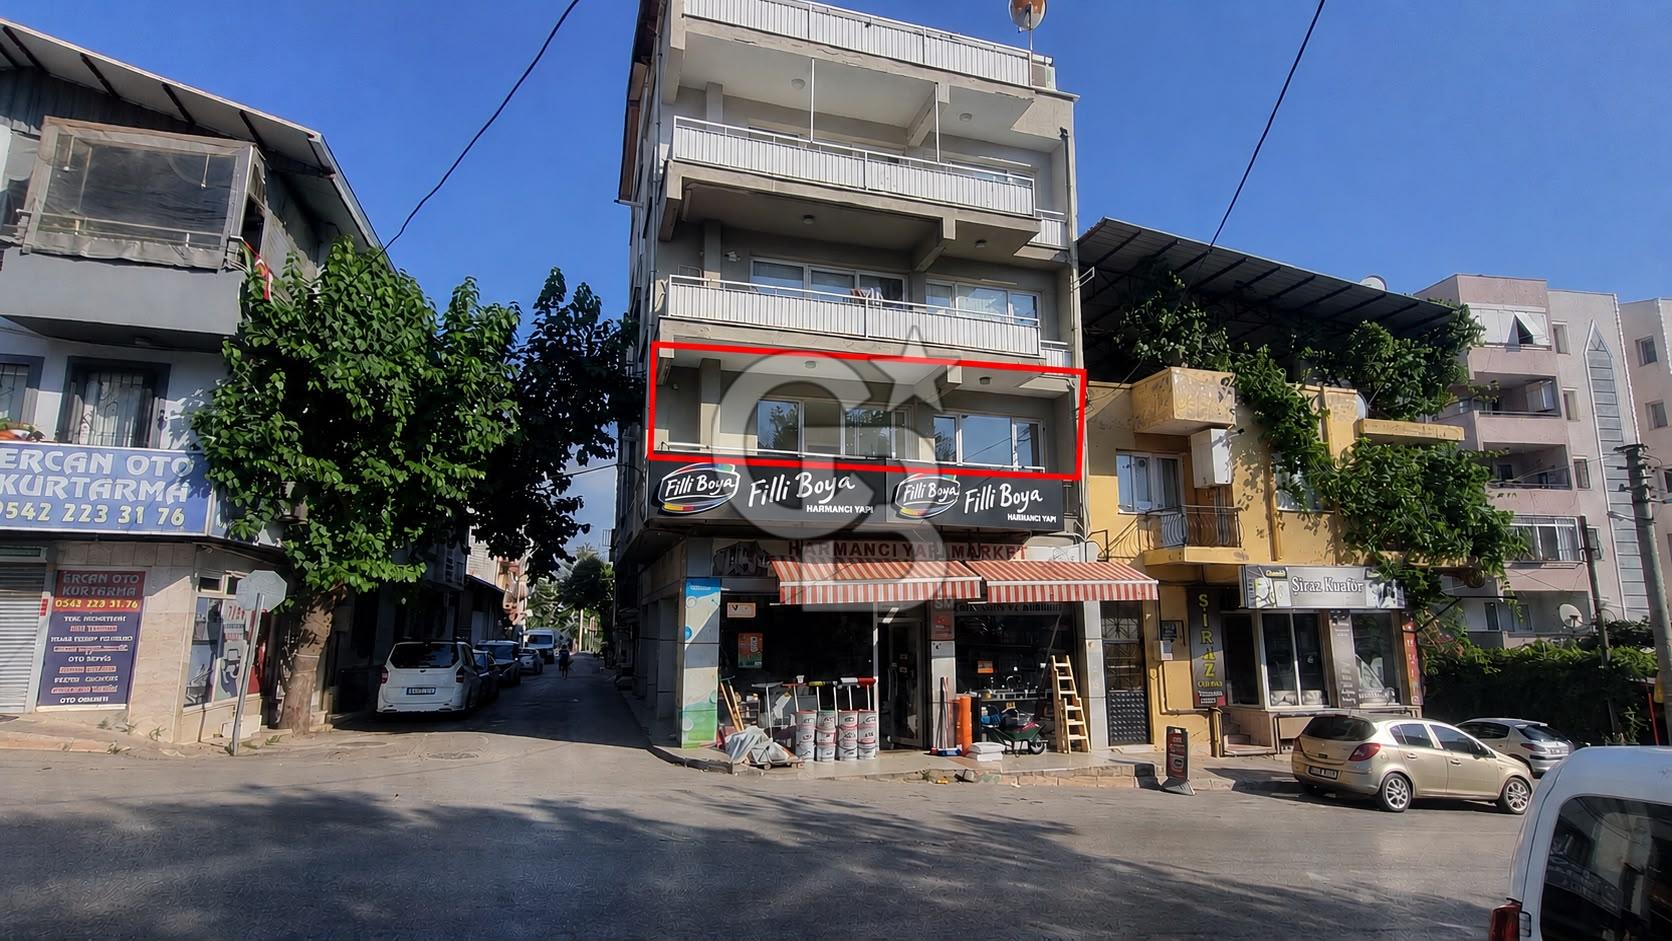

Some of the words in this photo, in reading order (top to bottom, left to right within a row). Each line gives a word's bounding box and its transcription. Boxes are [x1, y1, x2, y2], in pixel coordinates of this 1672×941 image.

[0, 448, 112, 475] ERCAN
[126, 455, 195, 477] OTO
[0, 473, 188, 504] KURTARMA
[664, 475, 695, 498] Filli
[696, 474, 735, 496] Boya
[748, 473, 791, 508] Filli
[795, 471, 856, 504] Boya
[903, 483, 927, 503] Filli
[928, 482, 959, 502] Boya
[806, 504, 853, 513] HARMANCI
[854, 505, 874, 514] YAPI
[964, 484, 997, 514] Filli
[999, 483, 1043, 513] Boya
[62, 503, 107, 523] 223
[118, 505, 145, 524] 31
[158, 507, 185, 526] 76
[788, 541, 898, 557] HARMANCI
[112, 574, 139, 584] OTO
